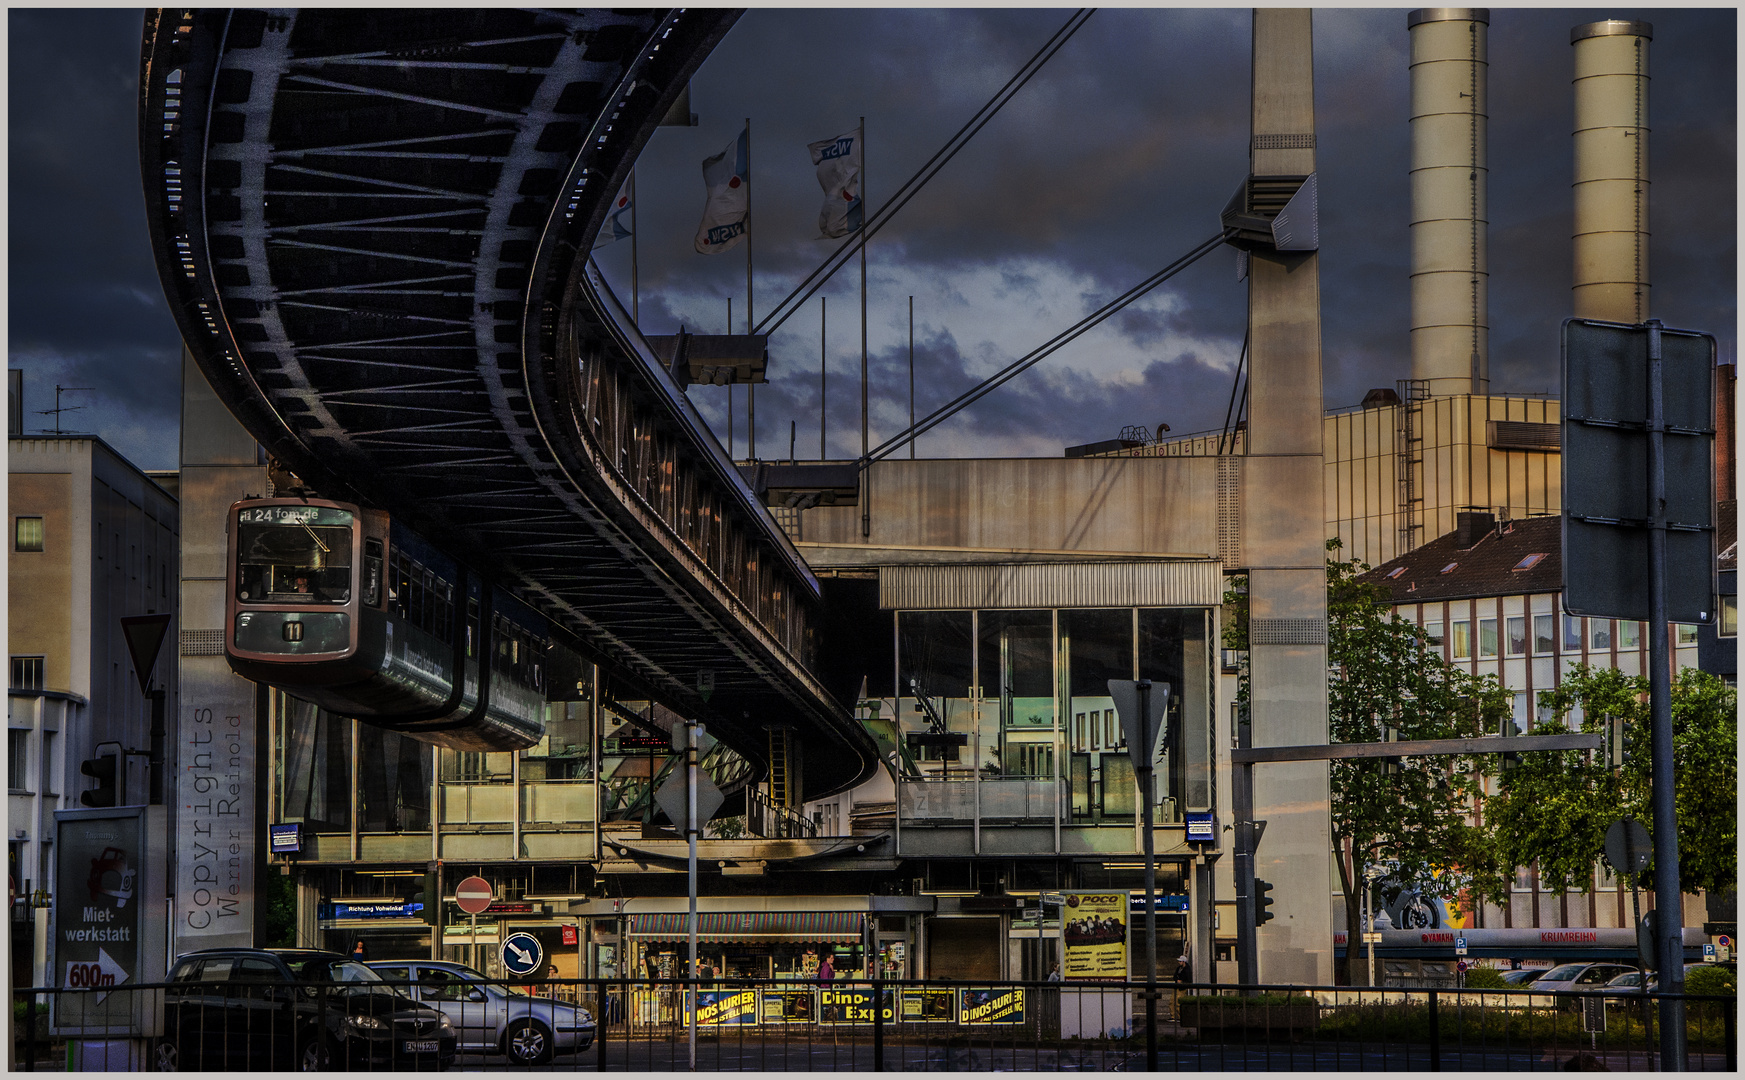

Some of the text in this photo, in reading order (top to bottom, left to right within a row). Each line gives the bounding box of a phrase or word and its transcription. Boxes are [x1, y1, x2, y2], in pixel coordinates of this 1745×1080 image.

[255, 509, 273, 522] 24
[287, 623, 301, 640] 11
[82, 906, 115, 923] Miet-
[65, 926, 131, 942] werkstatt
[1334, 934, 1347, 944] AHA
[1428, 933, 1454, 942] YAMAHA
[1541, 931, 1597, 943] KRUMREIHN
[1457, 939, 1464, 948] P
[1706, 945, 1713, 955] P
[69, 964, 115, 987] 600m
[822, 991, 870, 1005] Dino-
